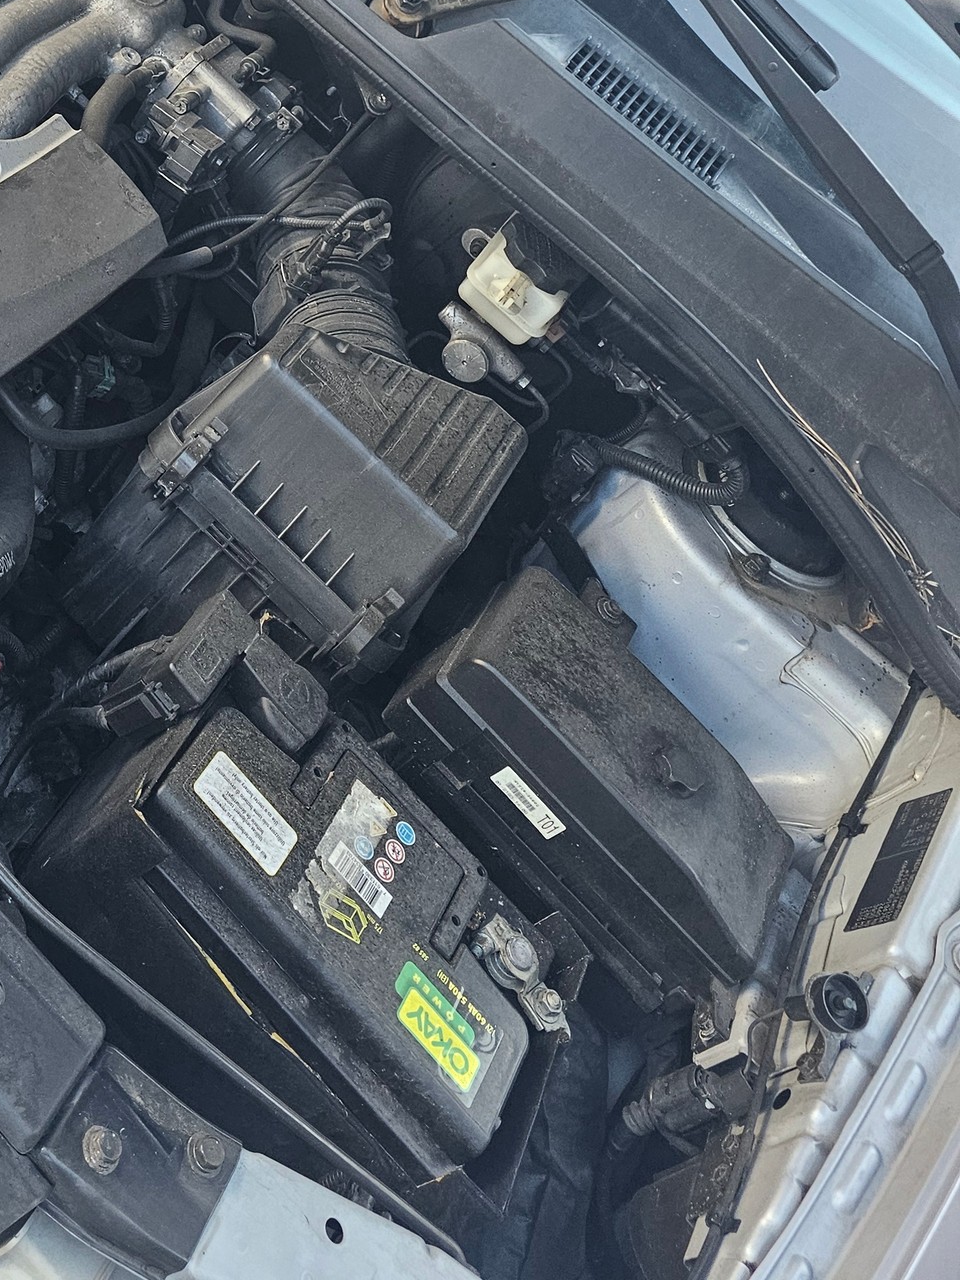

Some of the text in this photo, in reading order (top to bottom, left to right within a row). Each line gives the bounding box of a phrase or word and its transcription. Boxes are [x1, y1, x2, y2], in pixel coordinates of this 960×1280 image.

[537, 813, 559, 834] T01
[372, 921, 384, 935] 175
[413, 972, 466, 1033] POWER
[467, 1001, 487, 1026] 60Ah
[404, 1005, 470, 1073] OKAY
